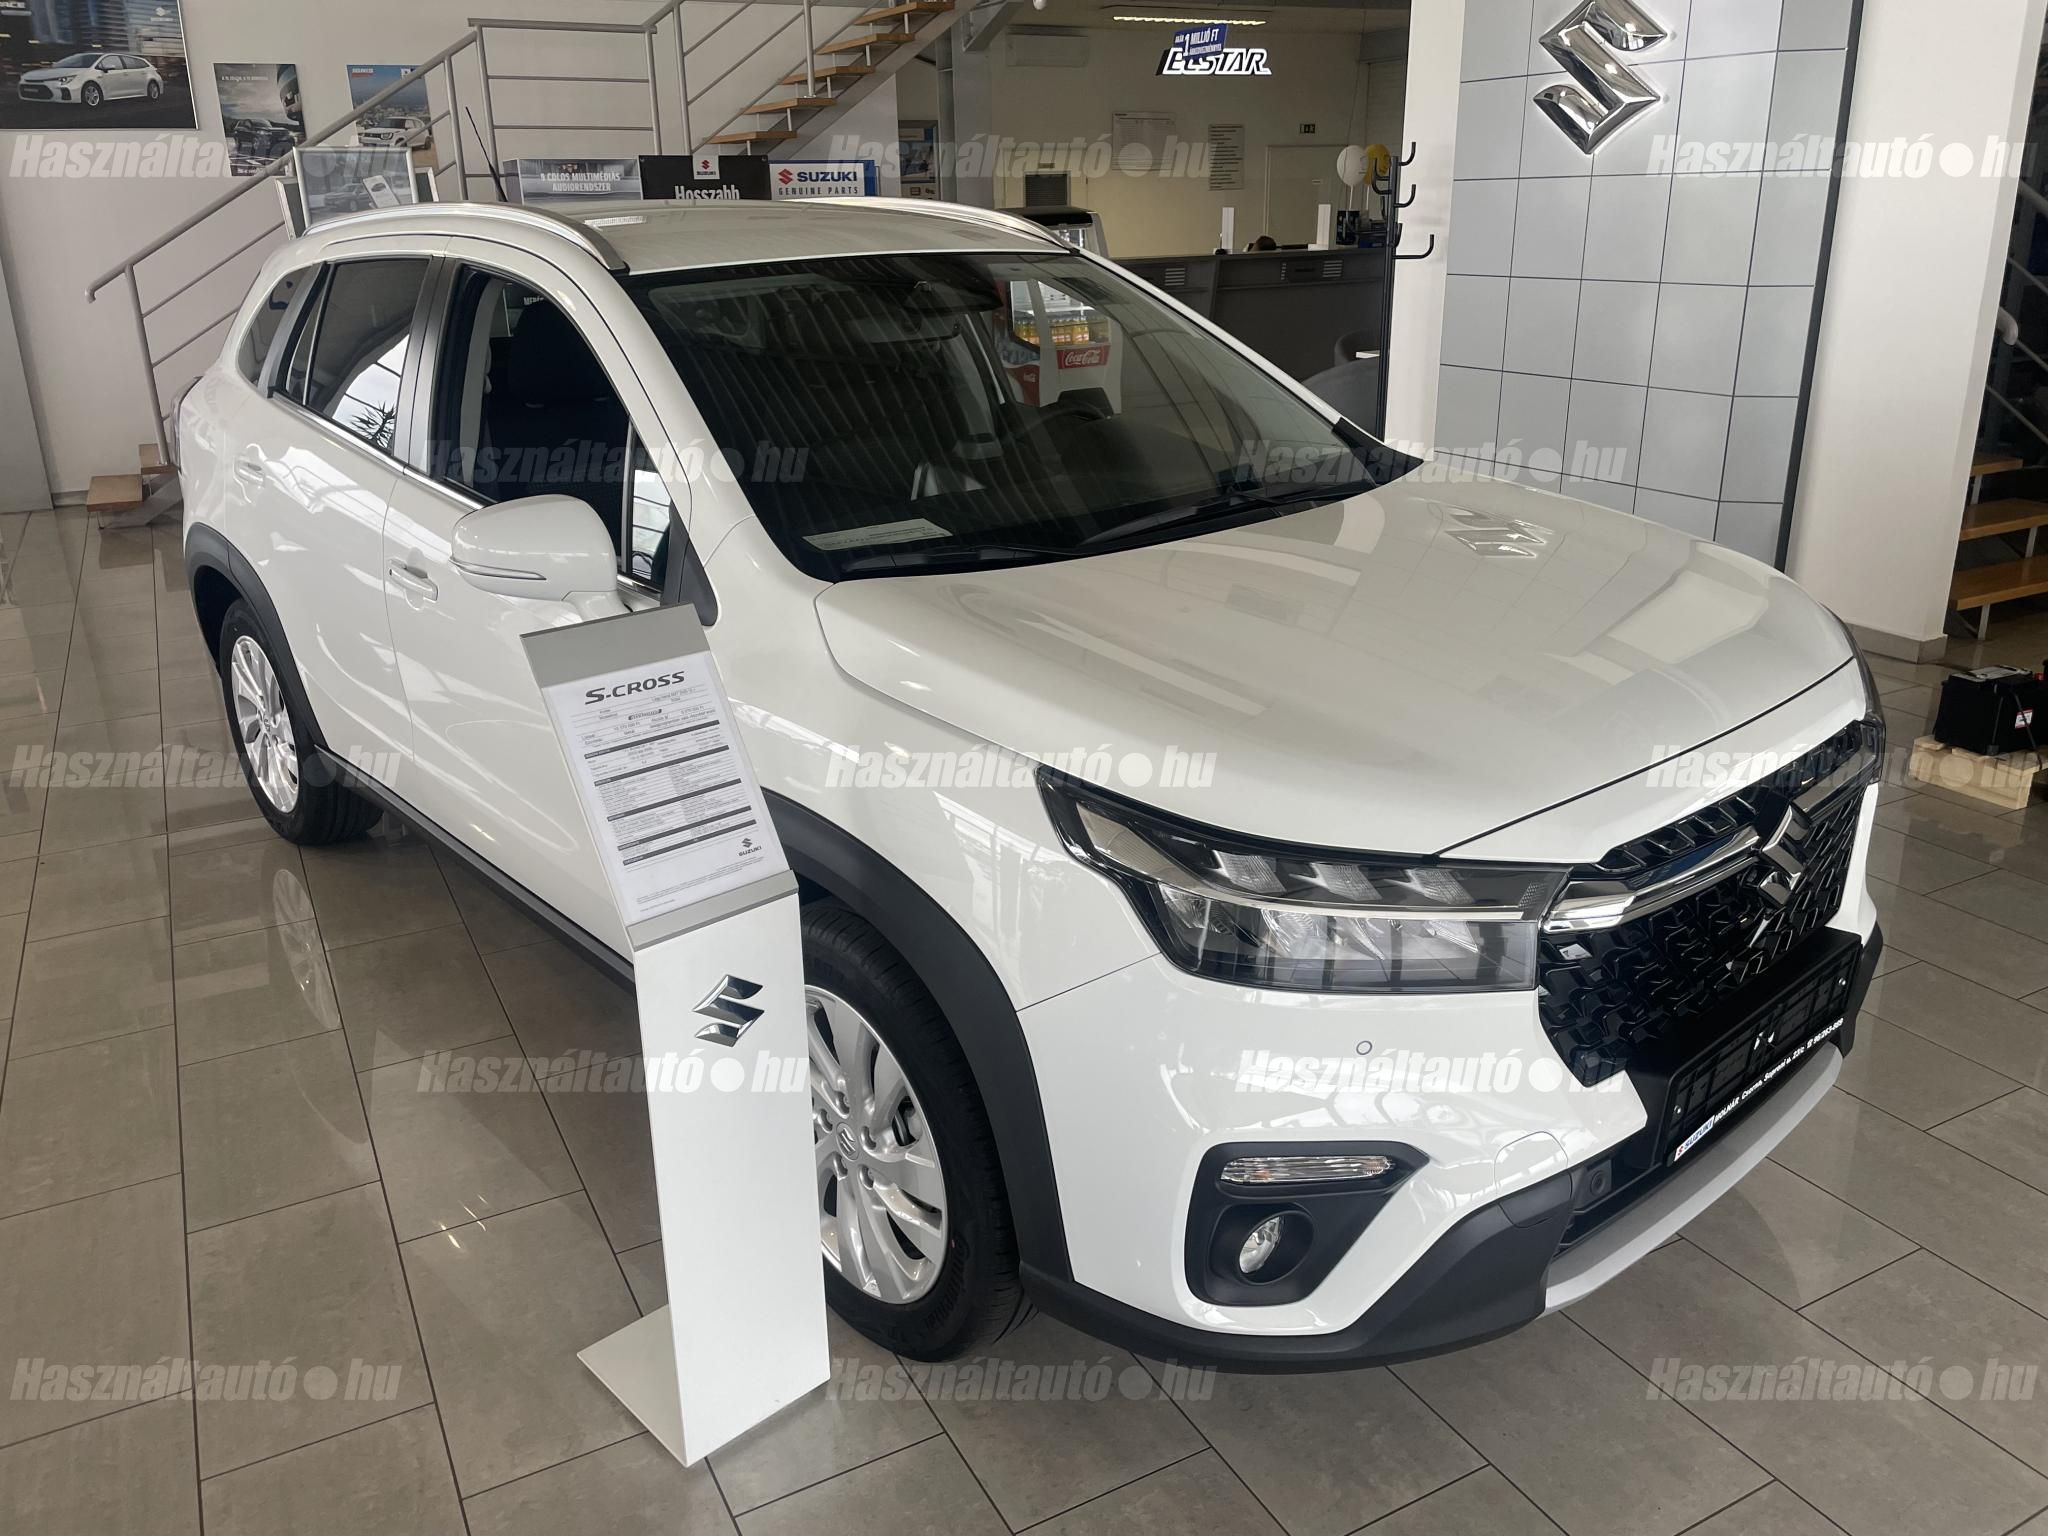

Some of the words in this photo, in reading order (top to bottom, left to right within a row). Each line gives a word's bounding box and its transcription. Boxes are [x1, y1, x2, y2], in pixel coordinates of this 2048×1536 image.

[797, 171, 858, 183] SUZUKI
[779, 187, 822, 196] GENUINE
[828, 186, 859, 195] PARTS
[584, 671, 685, 706] S-CROSS
[738, 845, 762, 857] SUZUKI
[1684, 1118, 1714, 1150] SUZUKI
